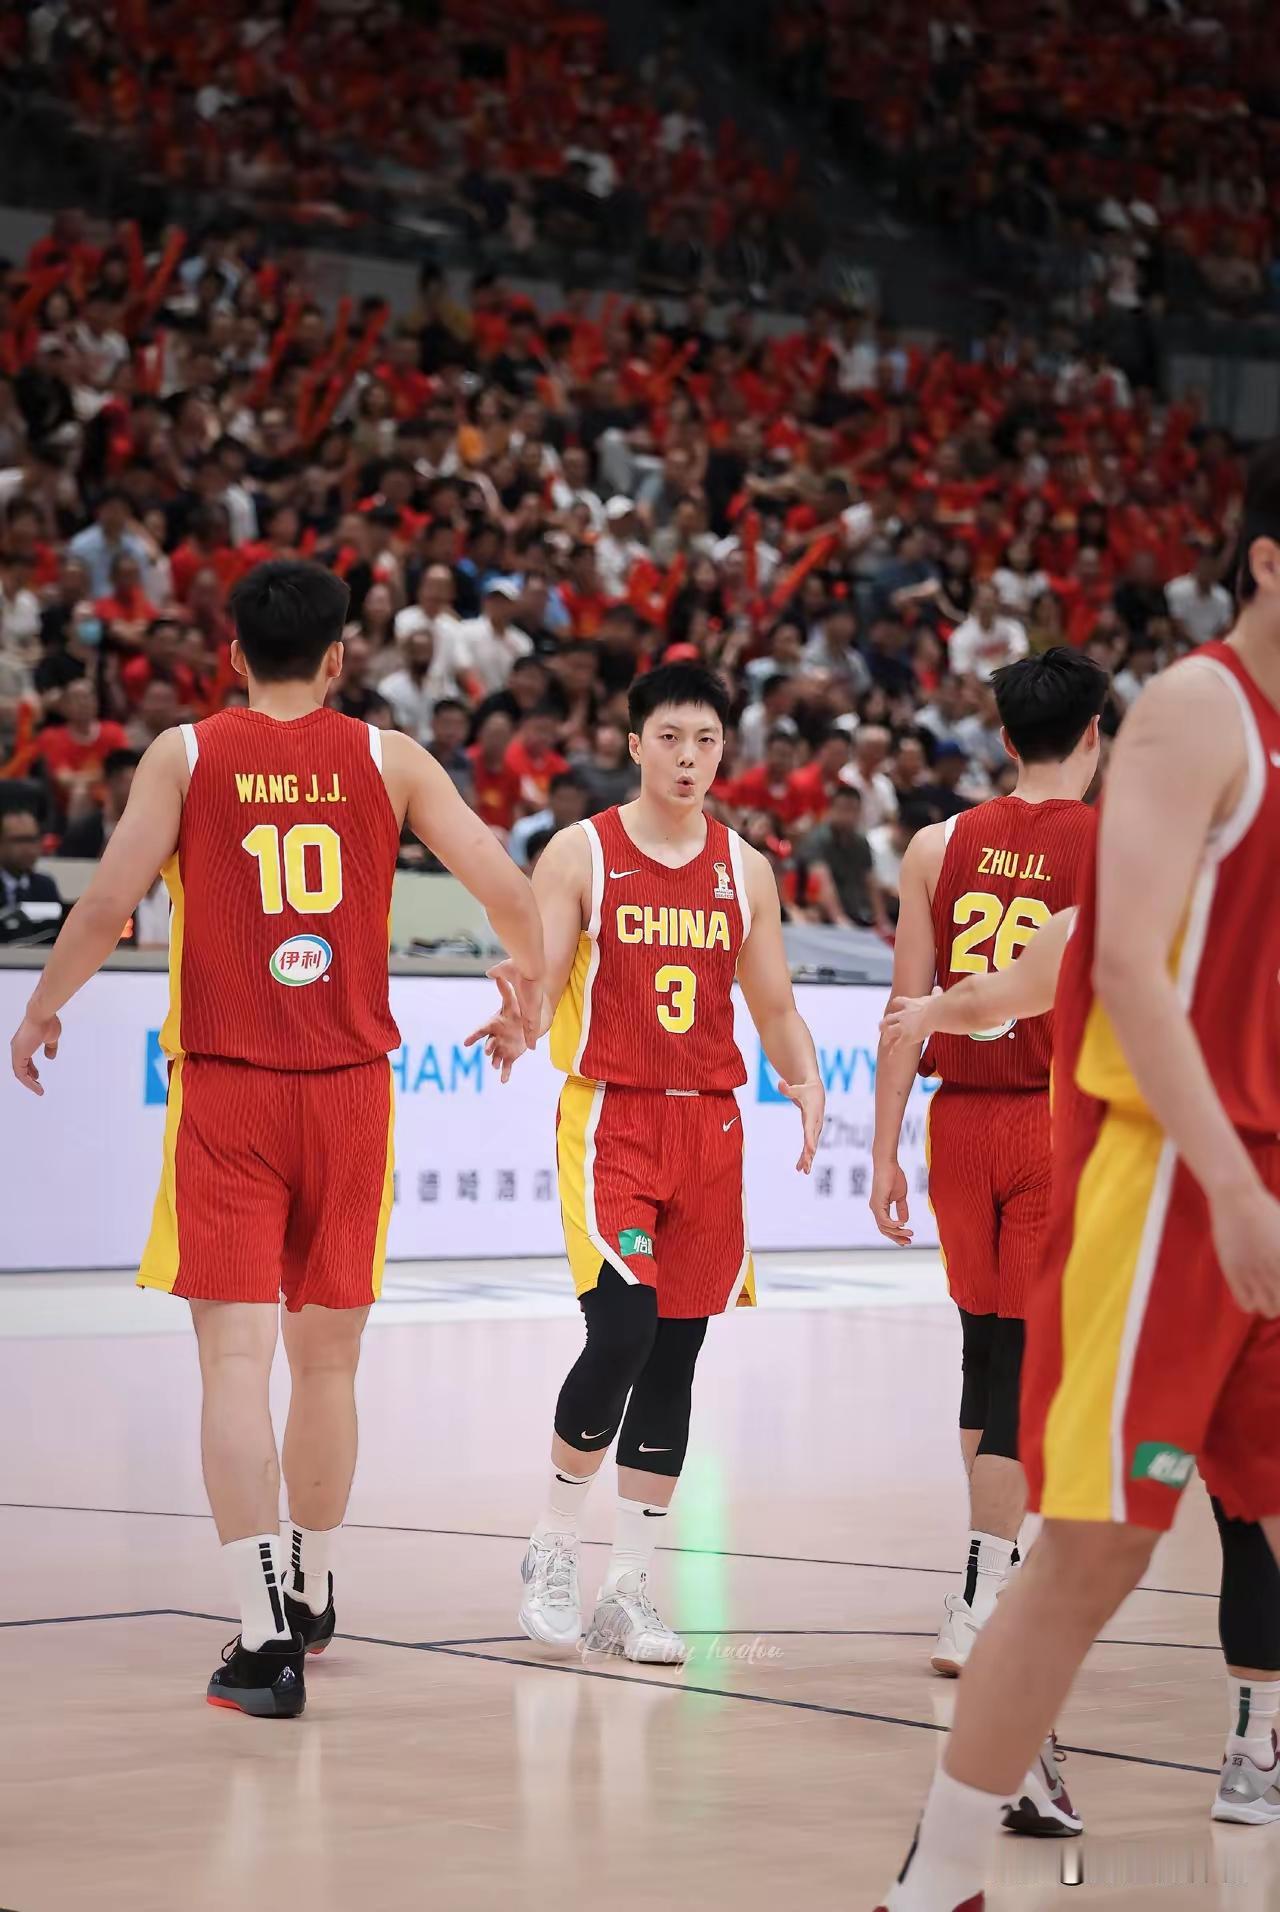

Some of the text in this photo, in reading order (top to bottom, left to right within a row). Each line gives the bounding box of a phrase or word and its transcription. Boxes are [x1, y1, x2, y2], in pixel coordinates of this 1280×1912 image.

[235, 773, 347, 803] WANG J.J.
[241, 823, 343, 915] 10
[977, 847, 1052, 881] ZHU J.L.
[615, 904, 731, 951] CHINA
[279, 951, 322, 970] 伊利
[654, 964, 697, 1034] 3
